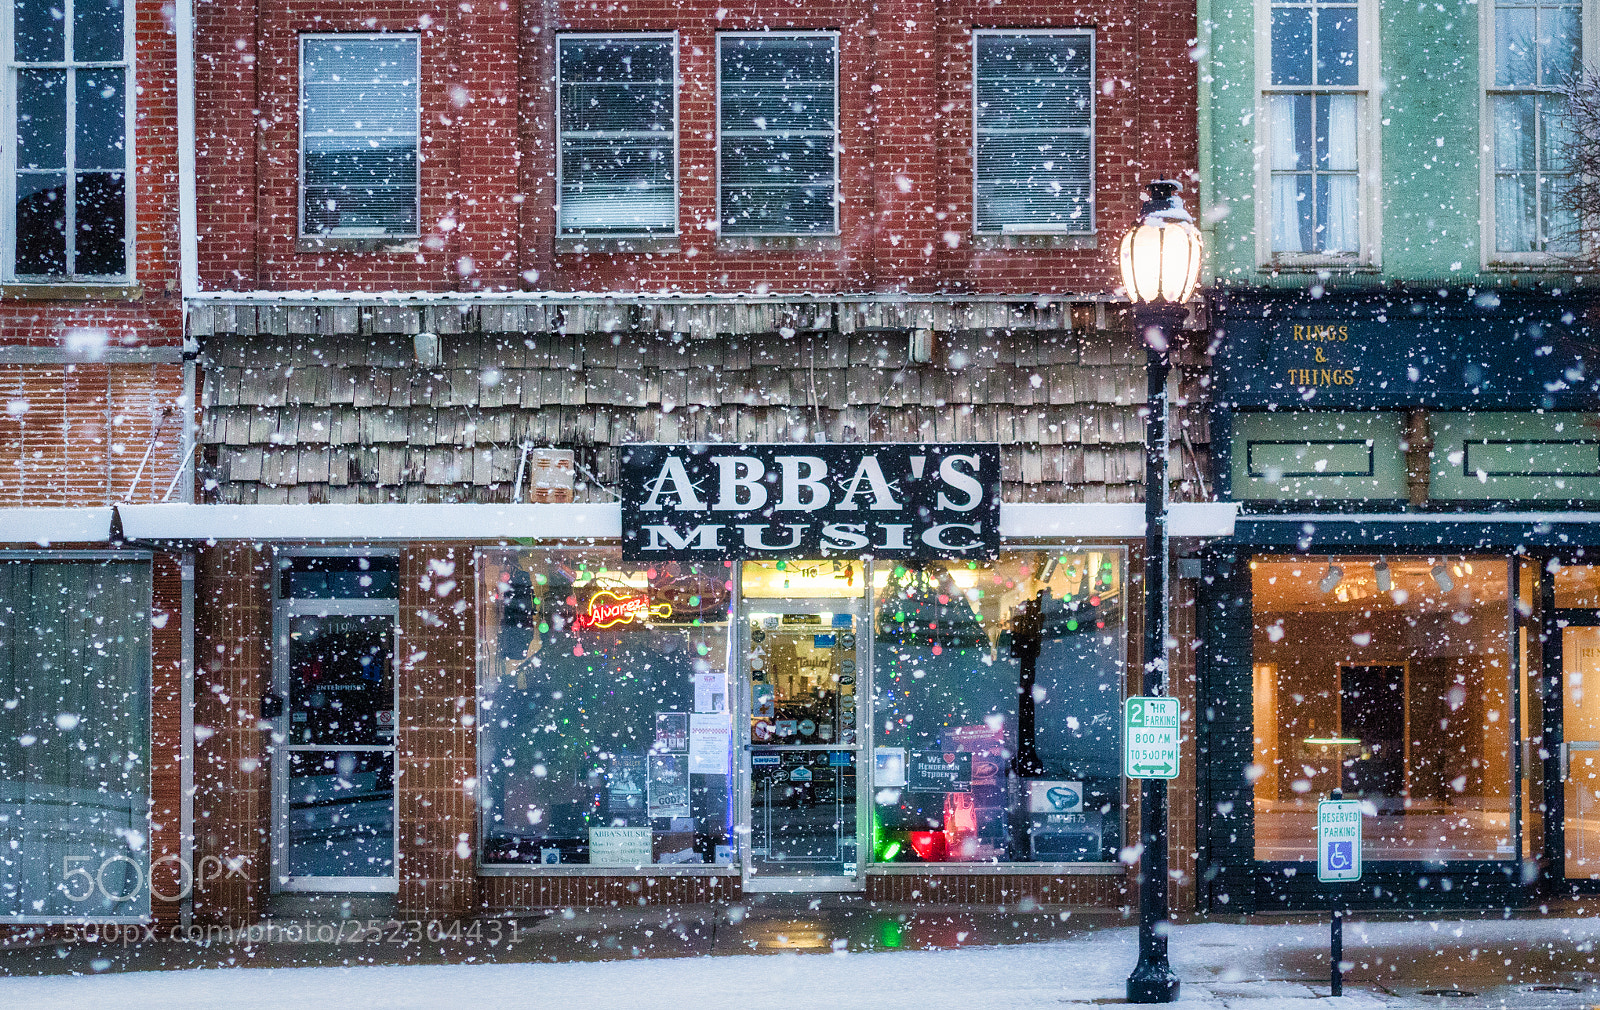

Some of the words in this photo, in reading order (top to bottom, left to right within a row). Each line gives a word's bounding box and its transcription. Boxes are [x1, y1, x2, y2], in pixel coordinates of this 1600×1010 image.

[1293, 325, 1348, 341] RINGS
[1315, 347, 1326, 363] &
[1288, 369, 1354, 385] THINGS
[640, 454, 983, 512] ABBA'S
[640, 524, 985, 551] MUSIC
[587, 599, 646, 626] Alvarez
[1131, 704, 1142, 723] 2
[1153, 703, 1166, 713] HR
[1145, 715, 1176, 726] PARKING
[1158, 733, 1171, 744] AM
[1131, 750, 1140, 760] TO
[1161, 750, 1174, 760] PM
[918, 763, 960, 771] HENDERSON
[1322, 812, 1357, 823] RESERVED
[1324, 827, 1356, 837] PARKING
